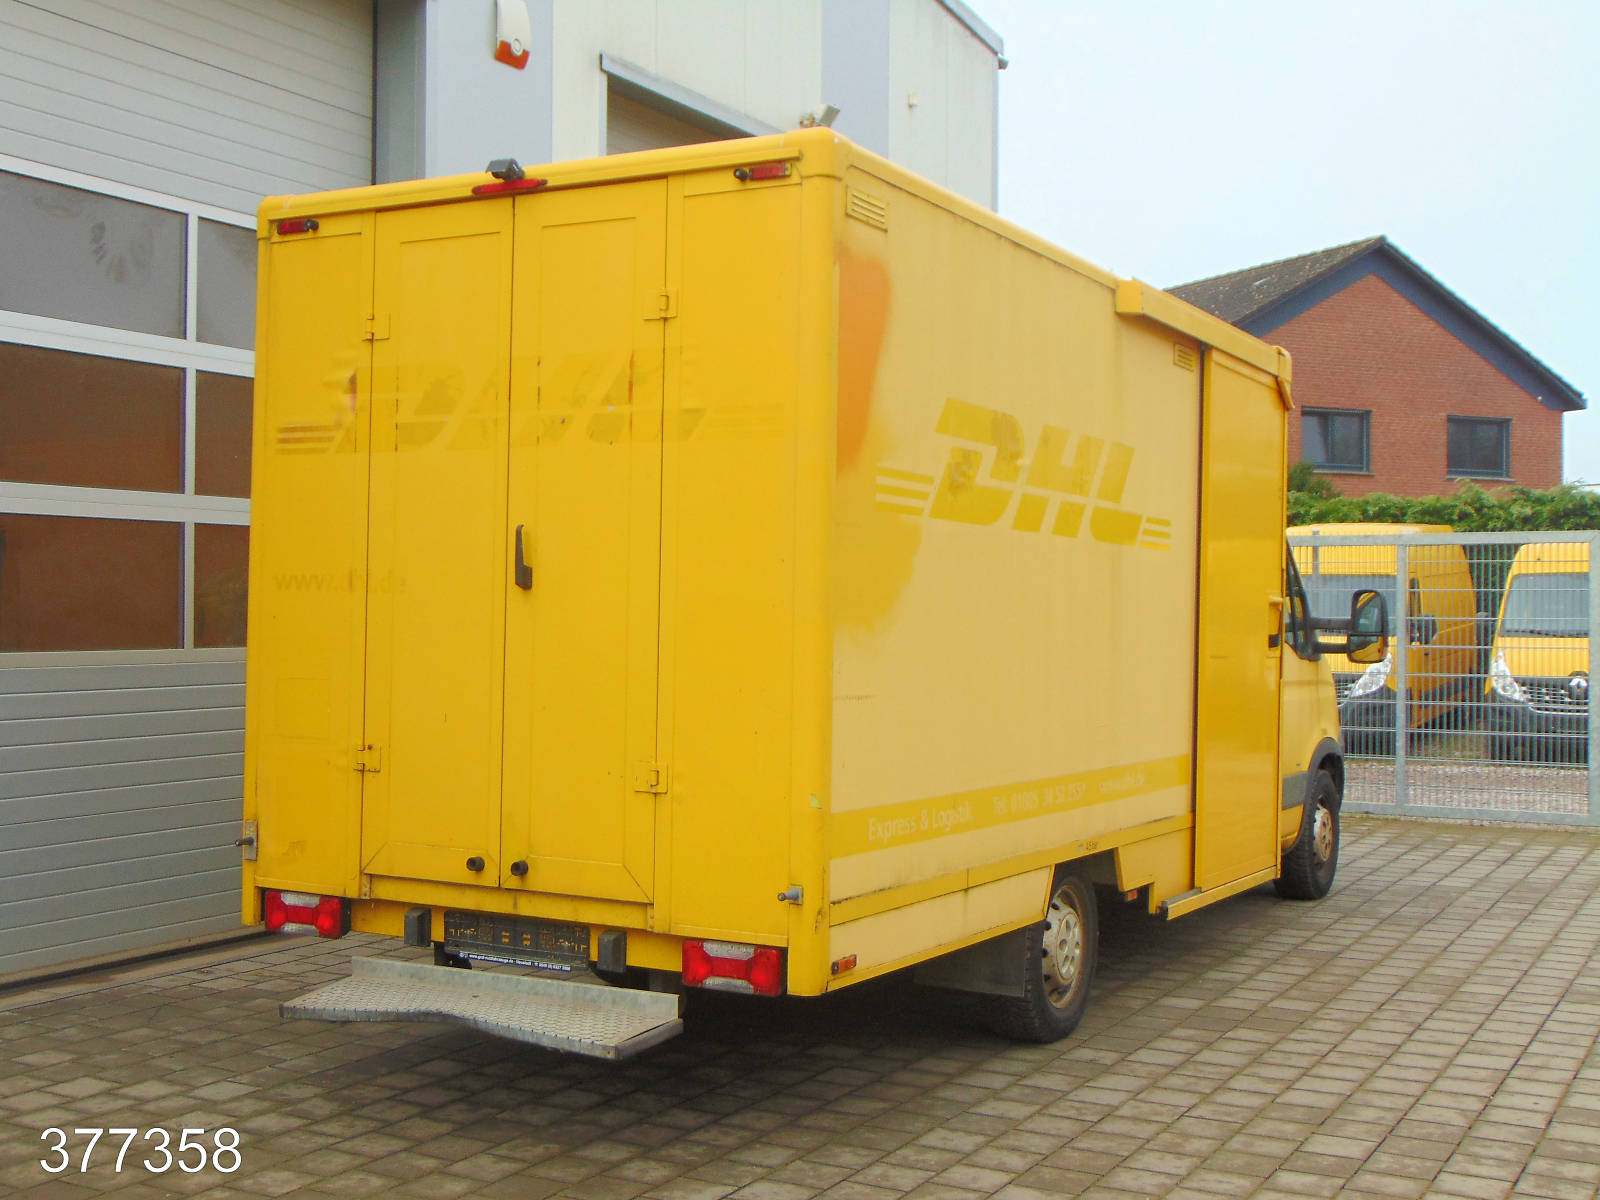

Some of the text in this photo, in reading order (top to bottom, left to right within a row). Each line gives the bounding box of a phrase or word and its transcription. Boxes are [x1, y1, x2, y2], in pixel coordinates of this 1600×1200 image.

[928, 397, 1143, 547] DHL
[868, 814, 917, 847] Express
[920, 808, 928, 831] &
[932, 799, 973, 832] Logistik
